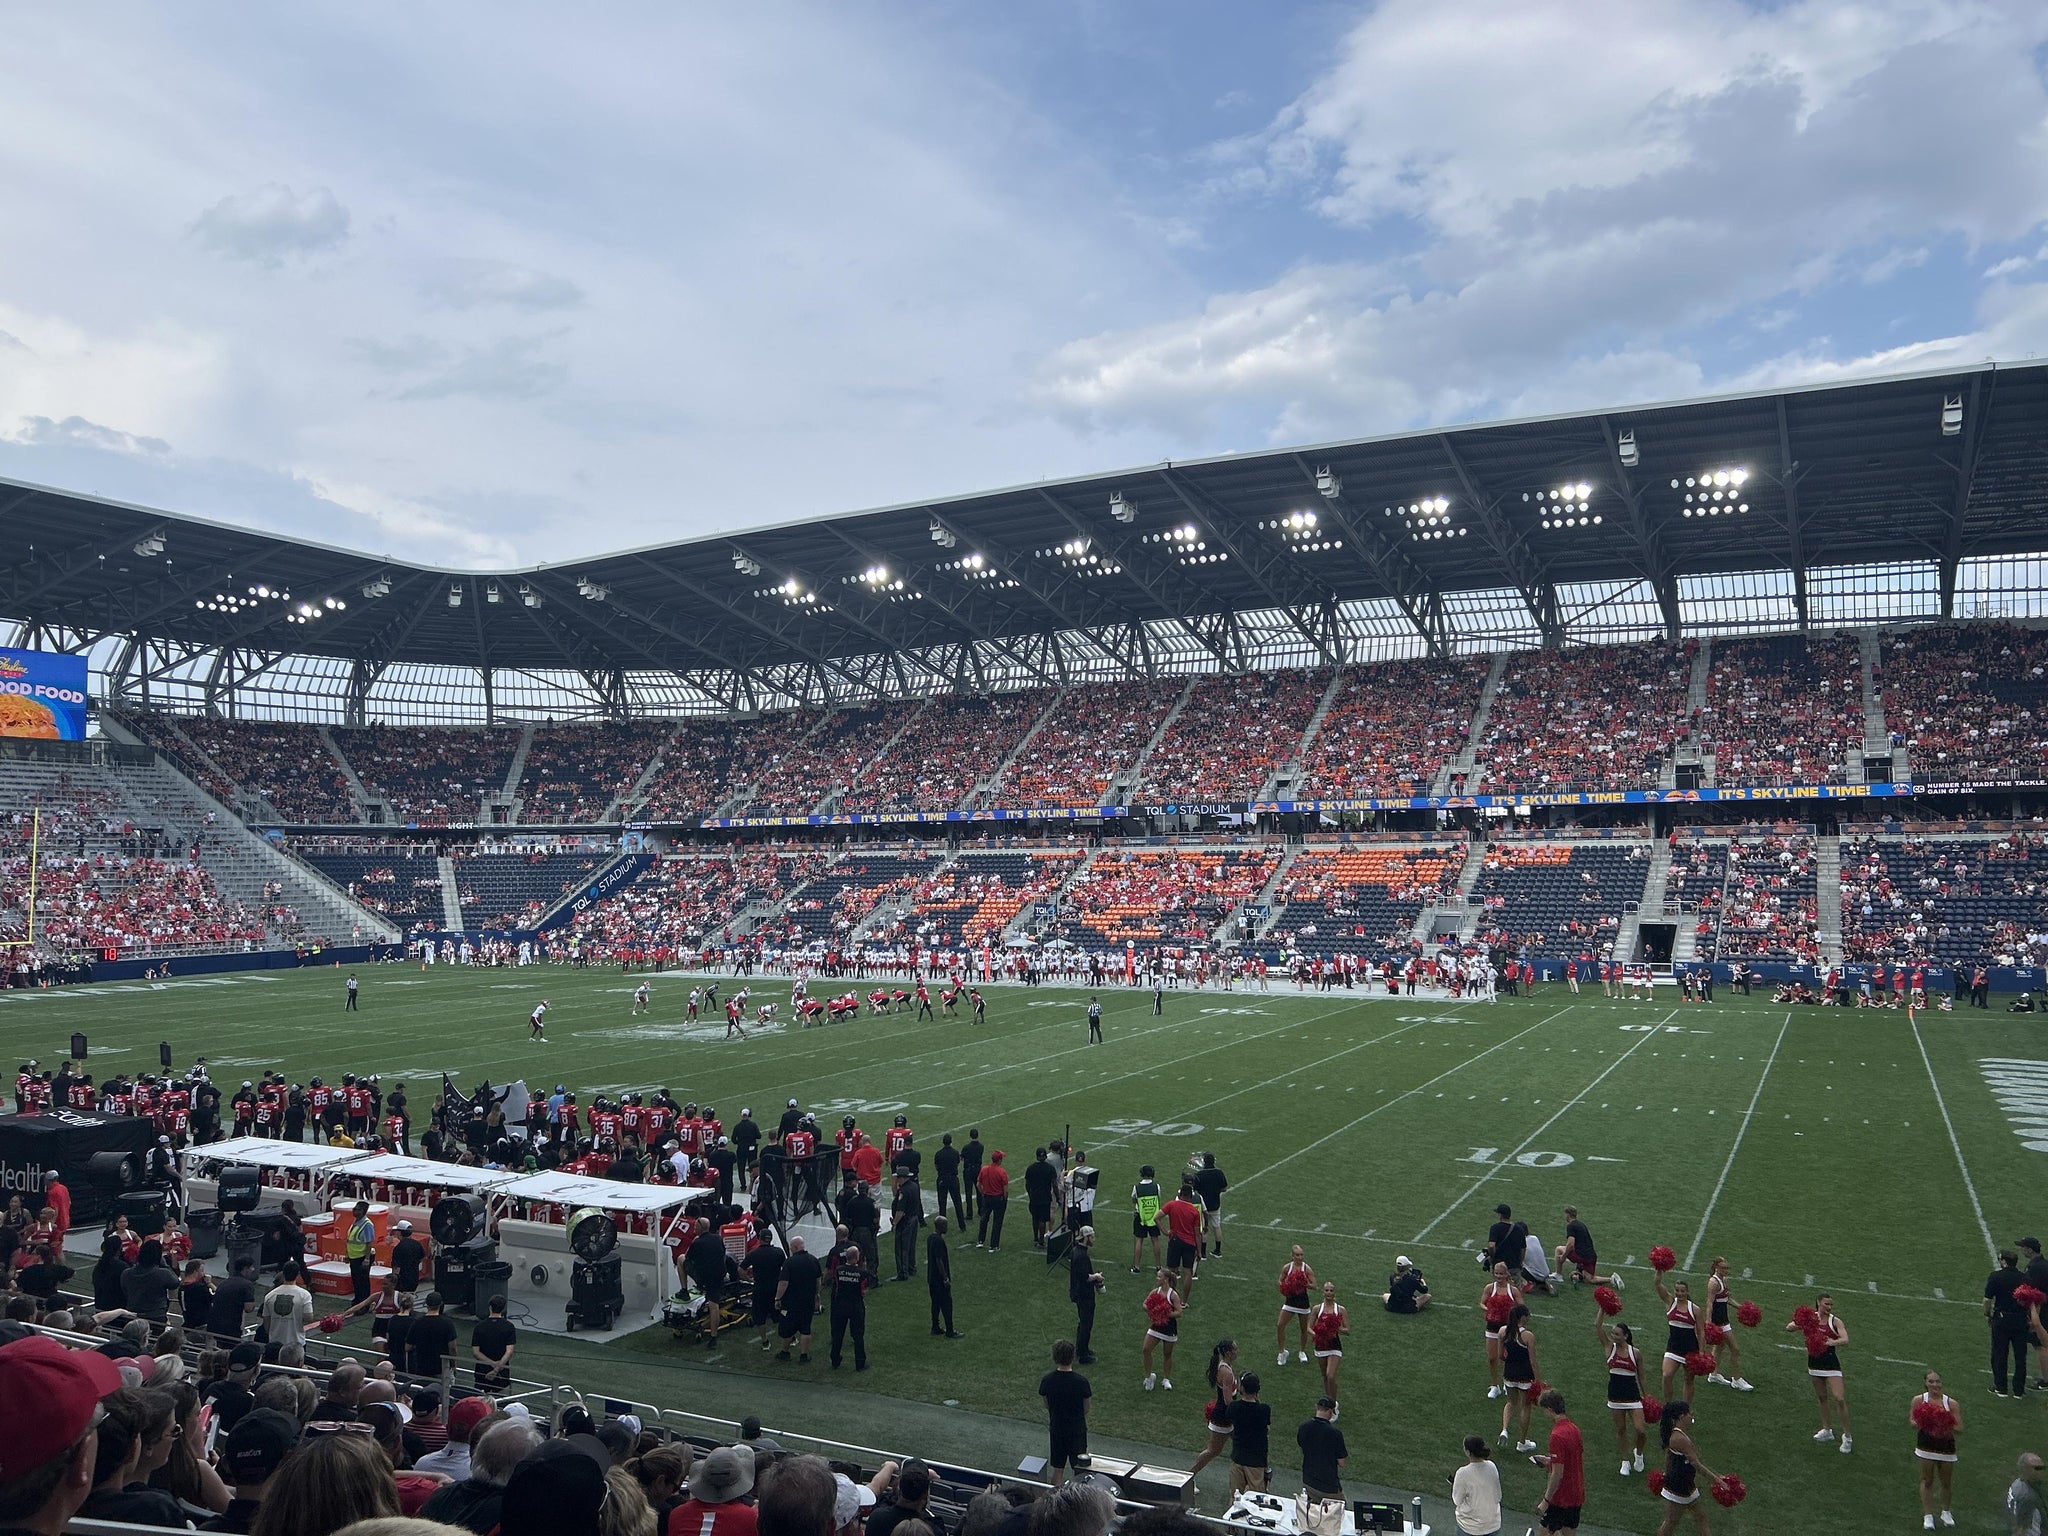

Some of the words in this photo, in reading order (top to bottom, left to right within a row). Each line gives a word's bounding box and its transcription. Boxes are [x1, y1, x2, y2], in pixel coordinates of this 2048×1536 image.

[35, 684, 84, 704] FOOD
[1491, 796, 1516, 806] IT'S
[1521, 794, 1581, 805] SKYLINE
[1586, 792, 1626, 803] TIME!
[1718, 789, 1746, 800] IT'S
[1751, 787, 1819, 799] SKYLINE
[1826, 785, 1871, 796] TIME!
[1144, 806, 1167, 816] TQL
[1179, 804, 1231, 815] STADIUM
[1293, 802, 1315, 811] IT'S
[1320, 800, 1371, 810] SKYLINE
[1376, 799, 1411, 808] TIME!
[861, 814, 877, 822] IT'S
[880, 813, 918, 822] SKYLINE
[921, 812, 947, 820] TIME!
[1006, 809, 1023, 819] IT'S
[1027, 808, 1070, 818] SKYLINE
[1073, 807, 1101, 817] TIME!
[729, 818, 744, 827] IT'S
[747, 817, 783, 826] SKYLINE
[785, 817, 809, 825] TIME!
[571, 895, 592, 912] TQL
[598, 855, 638, 893] STADIUM
[104, 947, 117, 961] 18
[313, 1092, 329, 1107] 85
[175, 1116, 187, 1130] 19
[256, 1108, 272, 1124] 25
[561, 1112, 569, 1125] 8
[623, 1112, 638, 1127] 80
[651, 1114, 663, 1129] 31
[600, 1121, 614, 1135] 35
[1089, 1118, 1205, 1136] 20
[680, 1128, 693, 1142] 91
[792, 1141, 806, 1156] 12
[844, 1137, 853, 1152] 5
[892, 1137, 905, 1151] 10
[1455, 1147, 1575, 1167] 10
